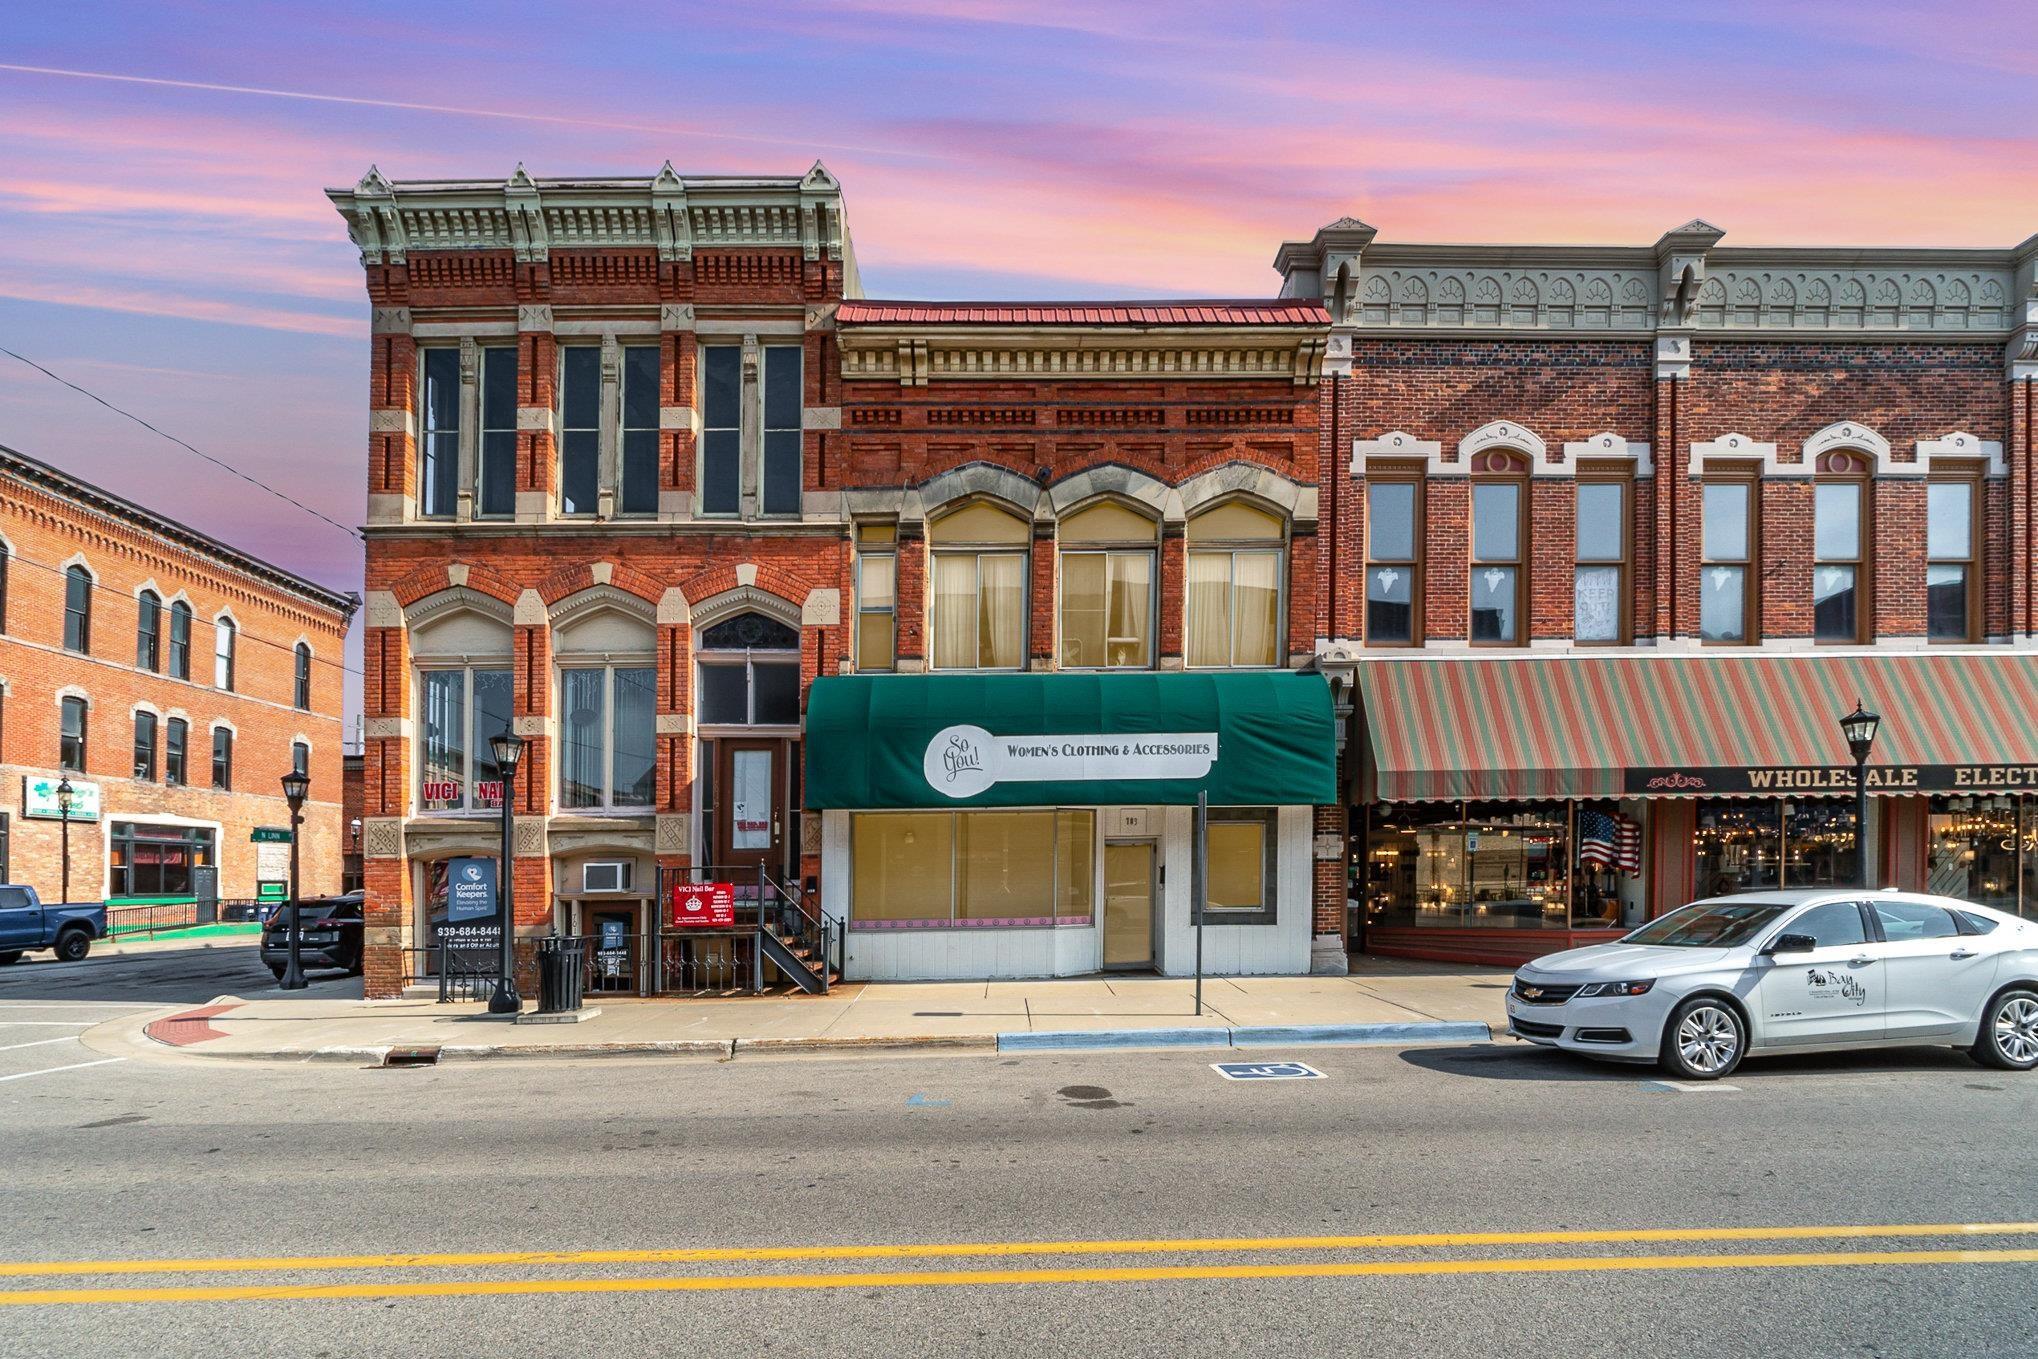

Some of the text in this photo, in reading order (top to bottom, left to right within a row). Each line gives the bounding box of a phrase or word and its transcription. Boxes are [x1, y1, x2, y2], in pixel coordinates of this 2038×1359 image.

[949, 734, 969, 752] So
[1007, 742, 1210, 757] WOMEN'S CLOTHING & ACCESSORIES
[943, 746, 983, 782] You!
[423, 781, 503, 801] VICI NAI
[261, 831, 280, 839] N LINN
[456, 882, 488, 891] Comfort
[678, 885, 715, 893] VICI Nail Bar
[1827, 970, 1853, 986] Bay
[1841, 981, 1866, 1006] City
